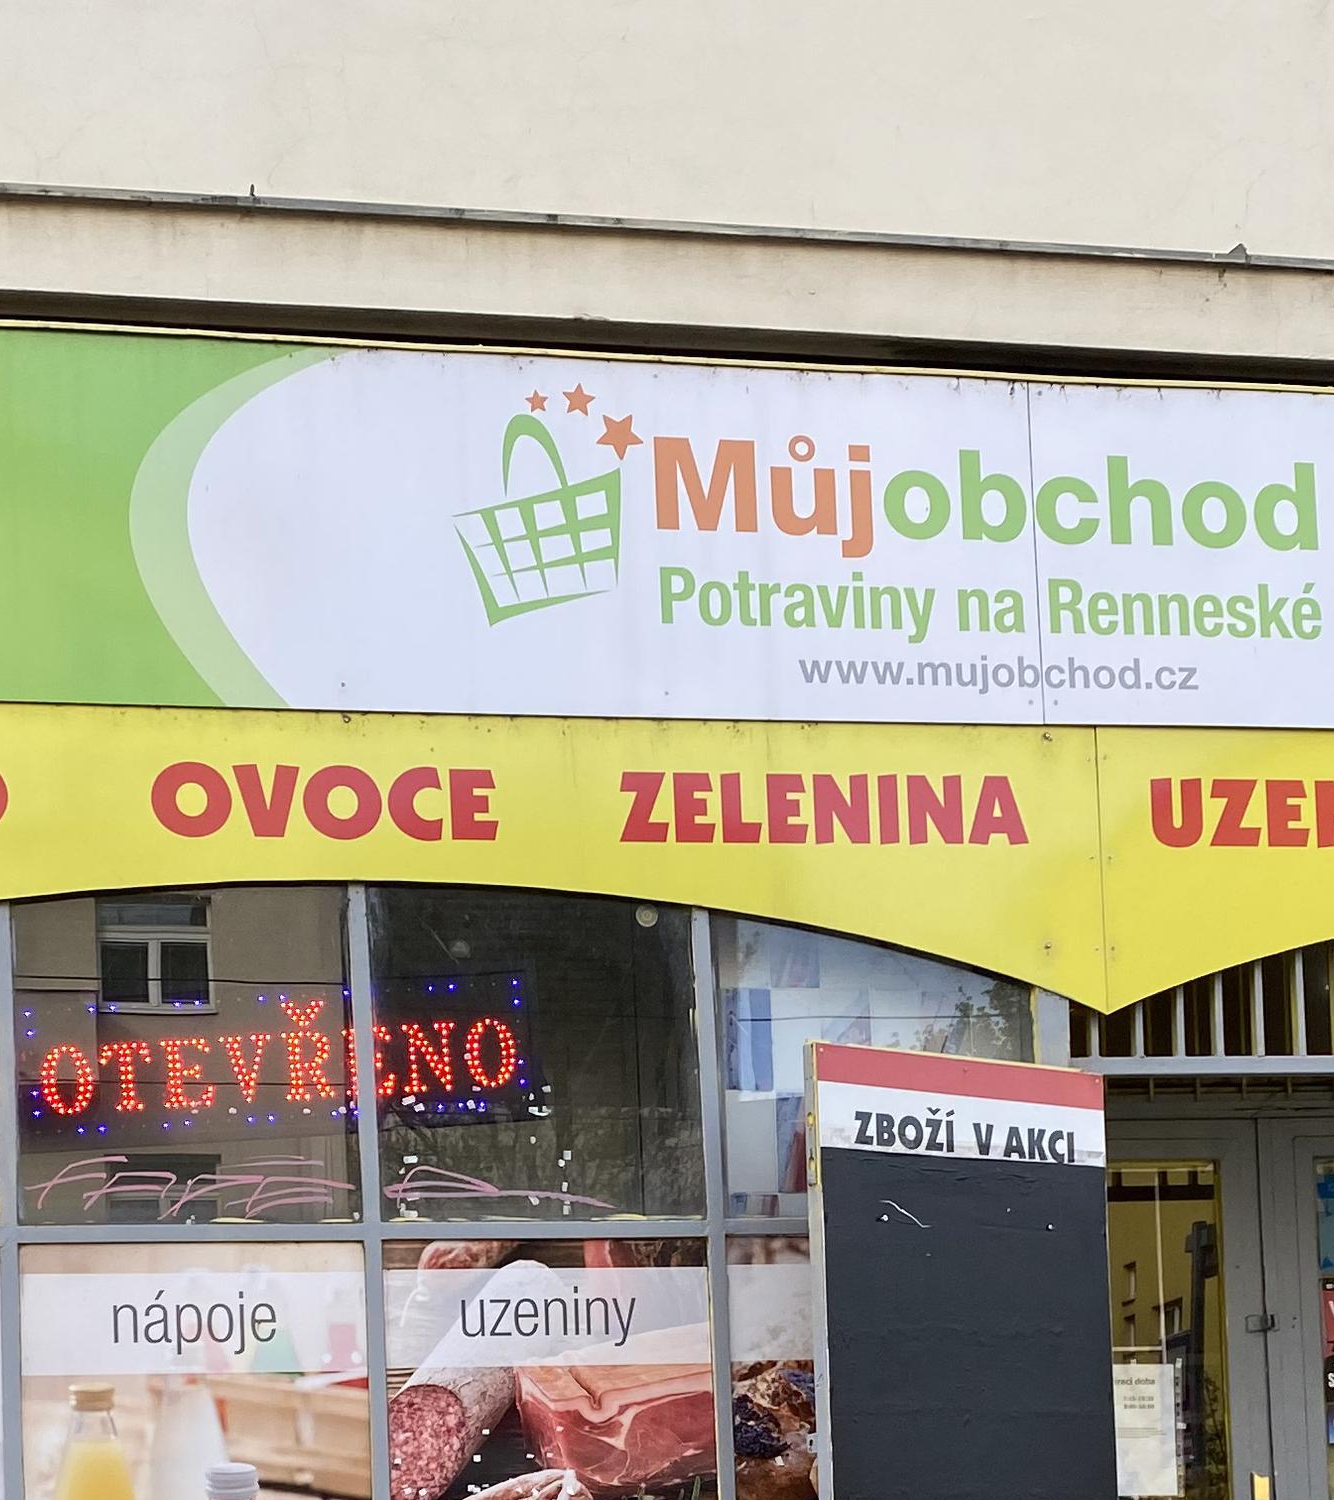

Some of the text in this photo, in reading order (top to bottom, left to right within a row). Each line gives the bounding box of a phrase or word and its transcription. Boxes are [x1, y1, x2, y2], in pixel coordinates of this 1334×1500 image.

[652, 434, 1319, 559] Můjobchod
[659, 565, 1322, 643] Potraviny na Renneské
[797, 653, 1200, 694] www.mujobchod.cz
[151, 761, 499, 842] OVOCE
[620, 771, 1029, 846] ZELENINA
[40, 1000, 516, 1114] OTEVŘENO
[854, 1107, 1075, 1164] ZBOŽÍ V AKCI
[112, 1289, 278, 1357] nápoje
[460, 1284, 637, 1348] uzeniny
